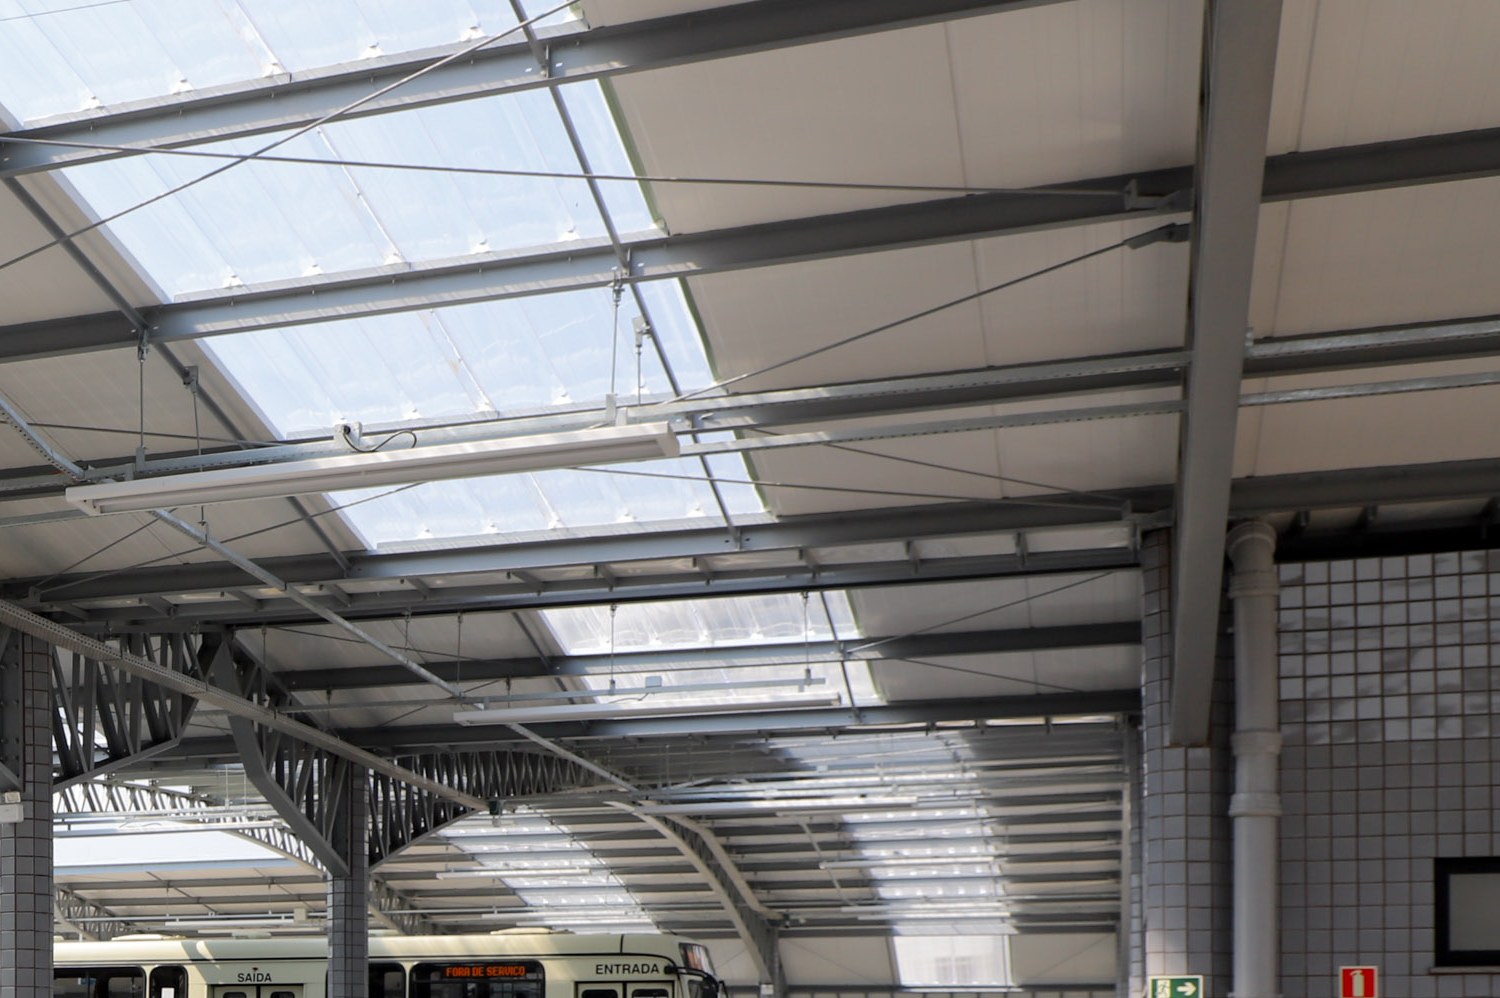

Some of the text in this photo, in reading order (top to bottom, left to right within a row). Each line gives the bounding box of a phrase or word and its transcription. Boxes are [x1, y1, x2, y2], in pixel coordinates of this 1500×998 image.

[446, 966, 470, 977] FORA
[472, 966, 485, 977] DE
[595, 963, 660, 975] ENTRADA
[237, 971, 272, 983] SAÍDA
